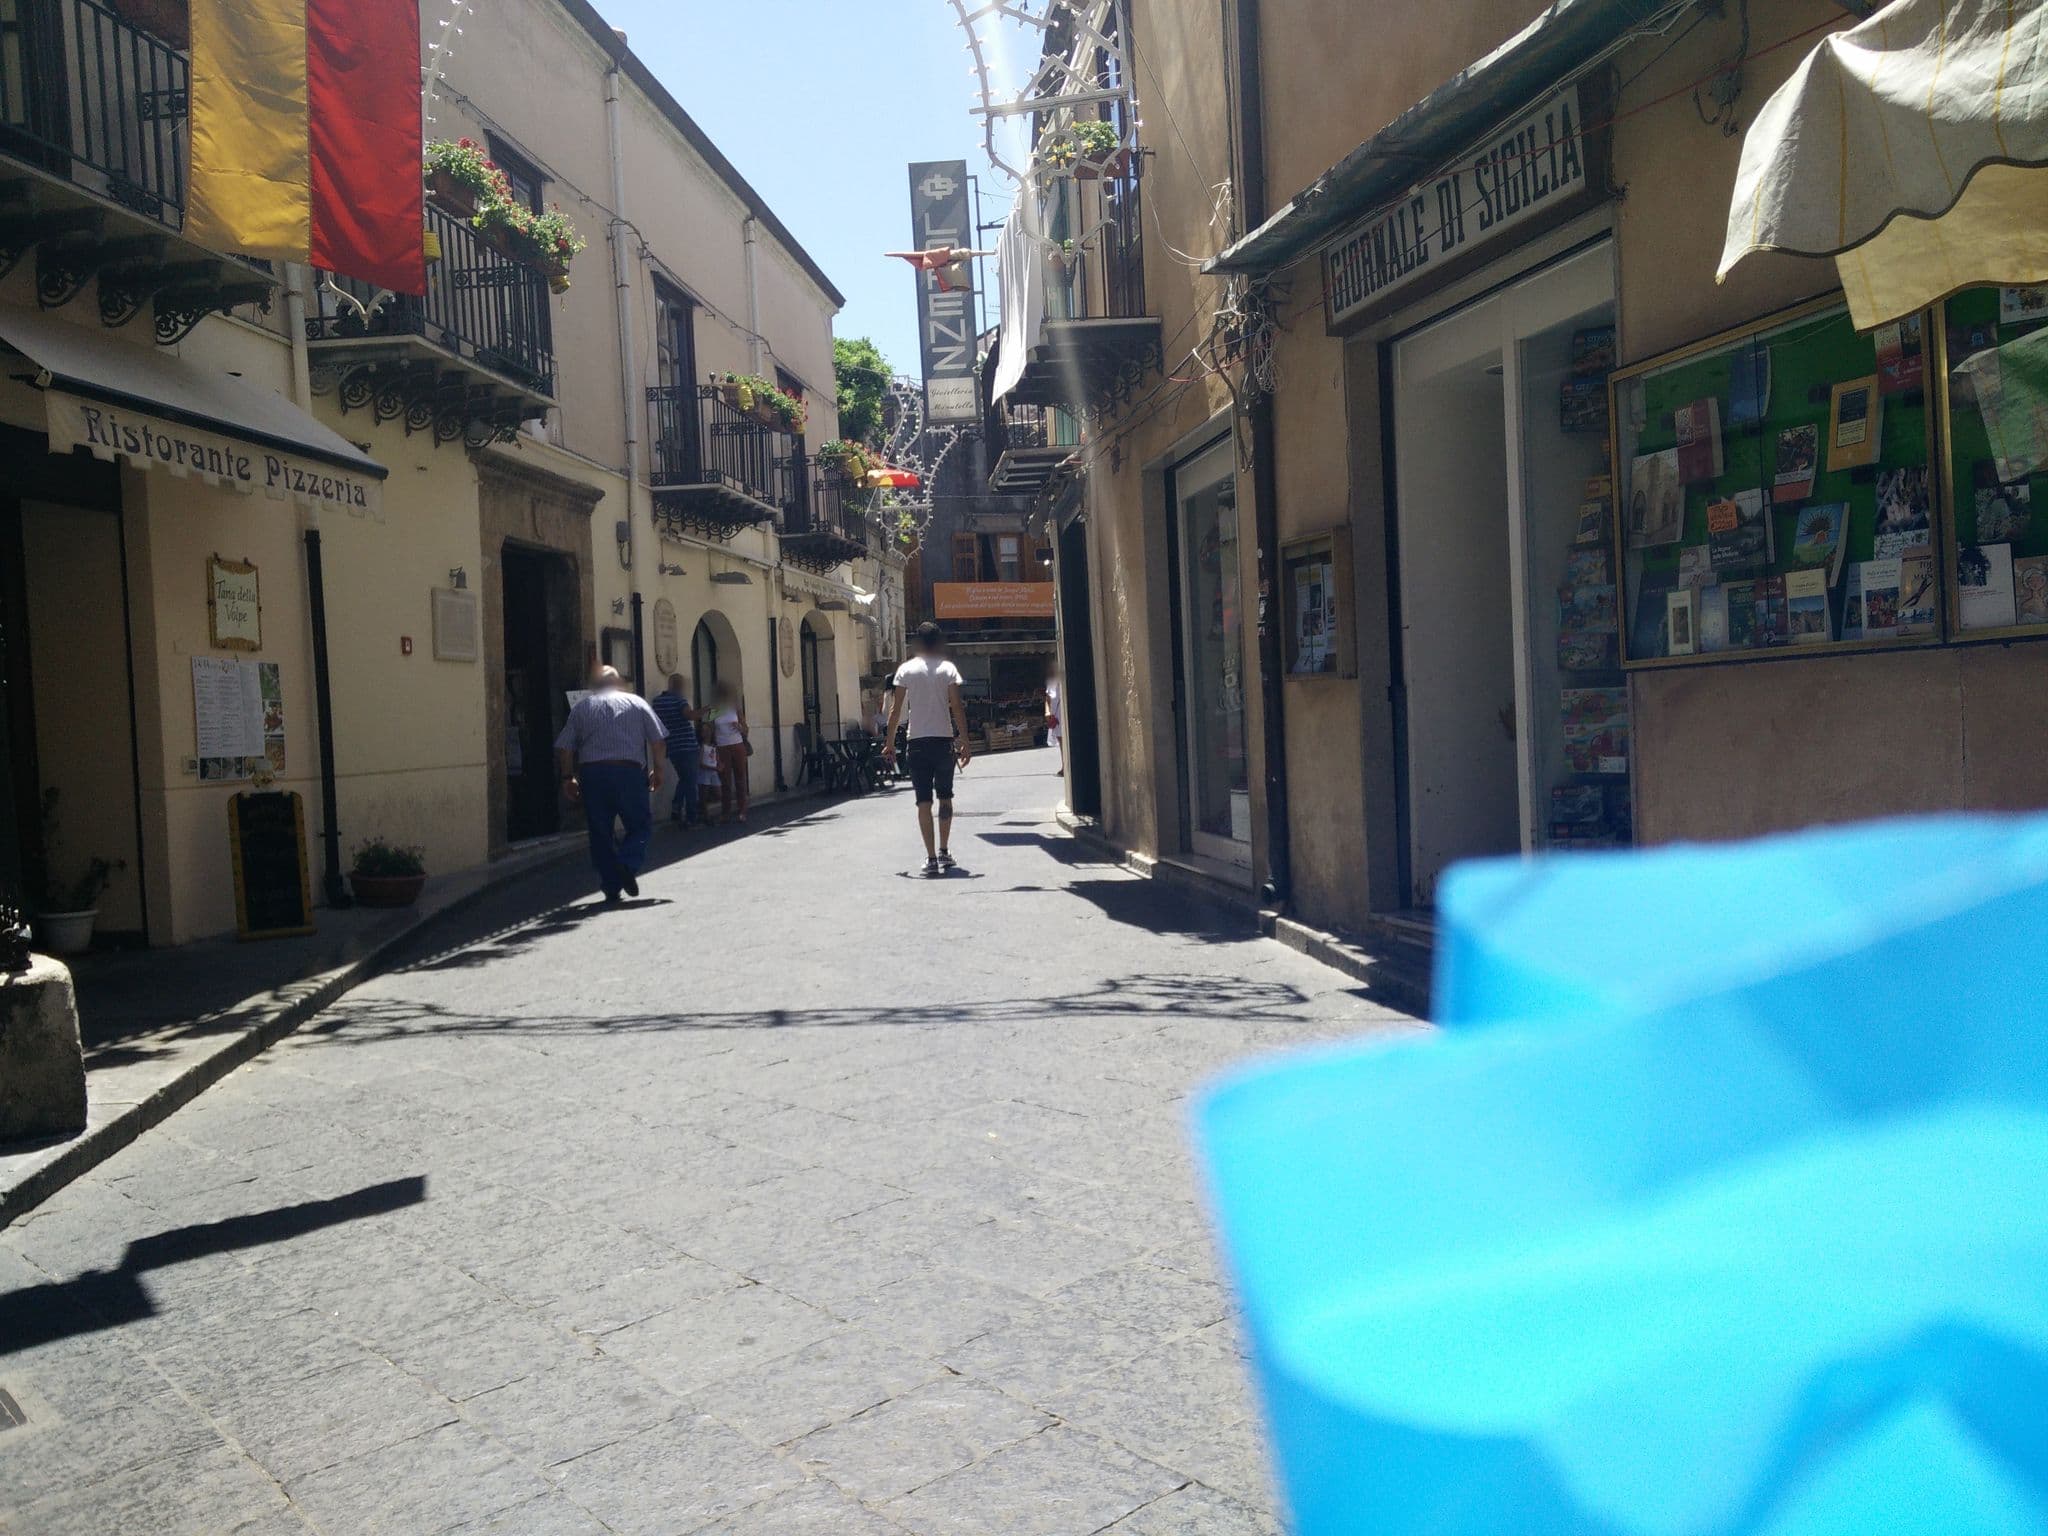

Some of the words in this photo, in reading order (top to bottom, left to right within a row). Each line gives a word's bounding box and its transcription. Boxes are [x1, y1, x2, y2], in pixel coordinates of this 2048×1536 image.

[1330, 196, 1429, 314] GIORNALE
[1436, 173, 1466, 253] DI
[1475, 102, 1583, 232] SICILIA
[80, 405, 251, 482] Ristorante
[264, 454, 368, 508] Pizzeria
[215, 580, 235, 603] Tana
[225, 604, 249, 628] Volpe
